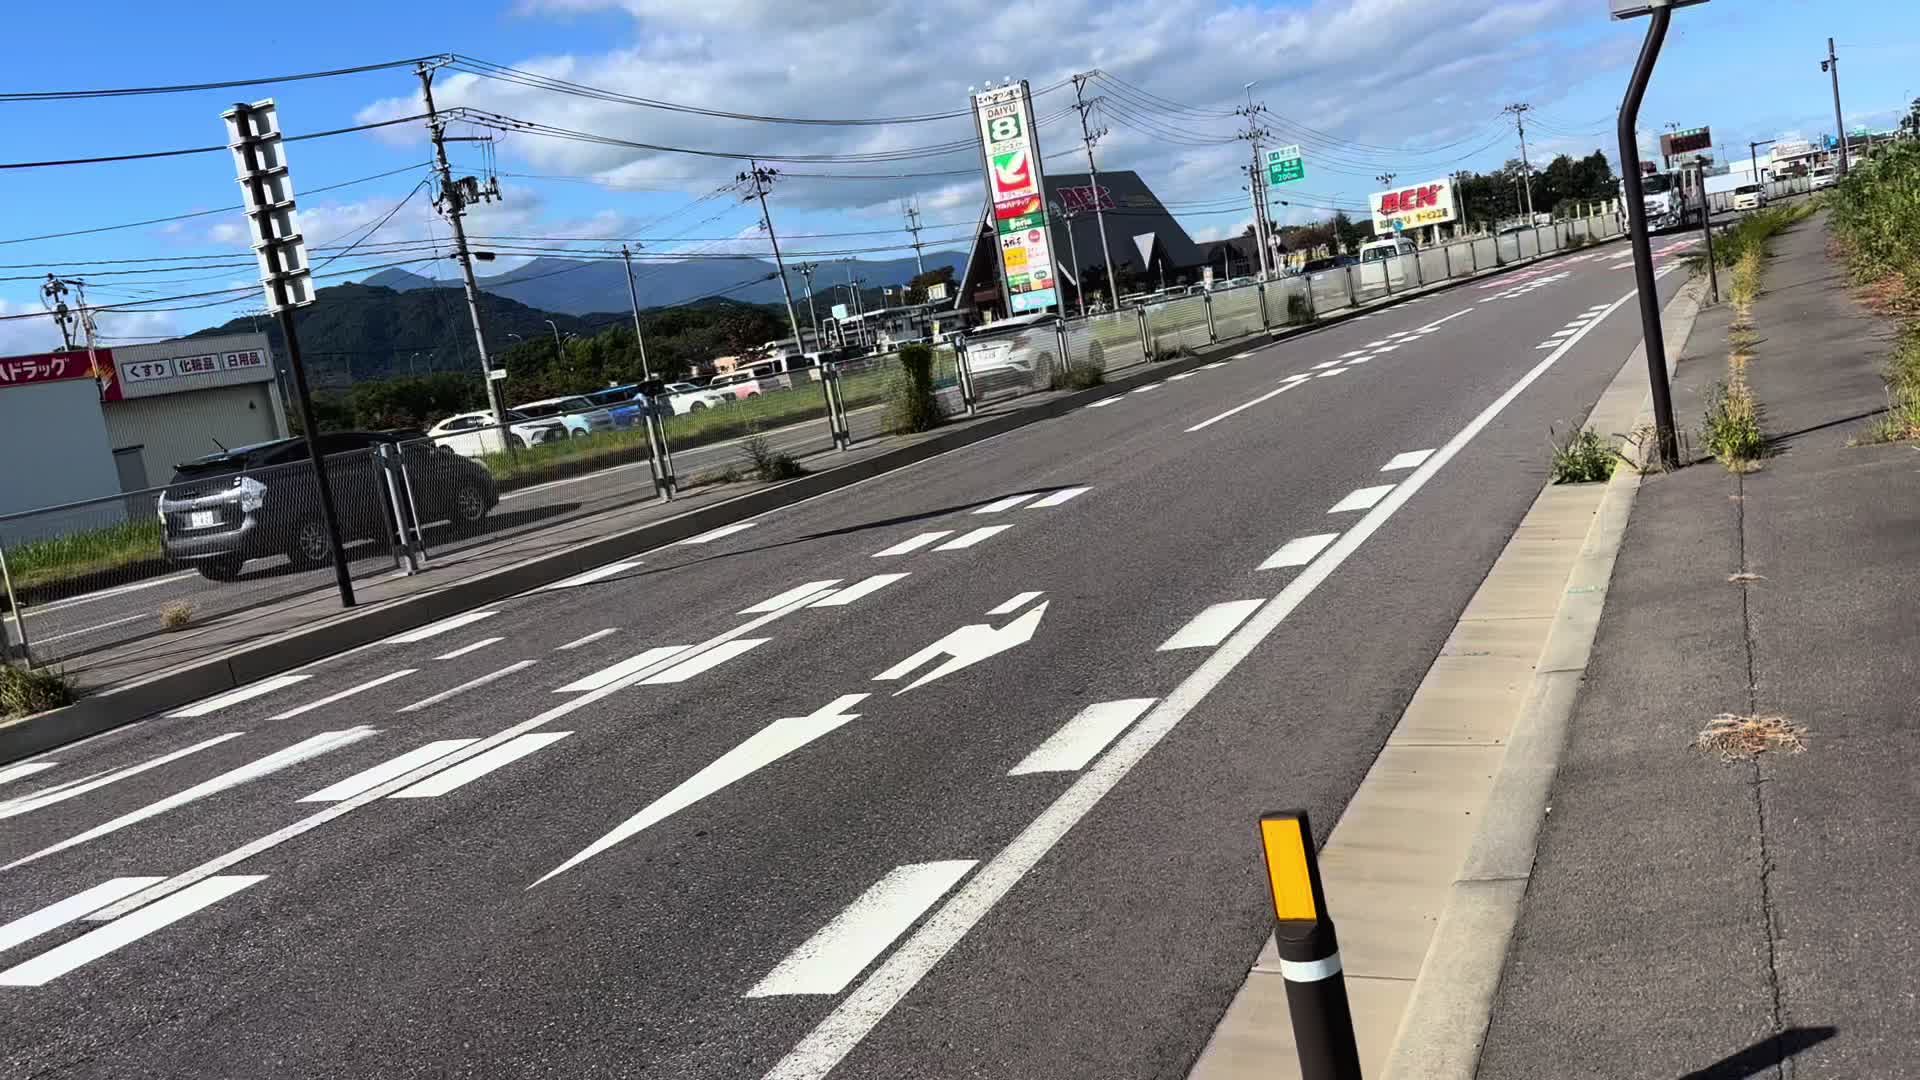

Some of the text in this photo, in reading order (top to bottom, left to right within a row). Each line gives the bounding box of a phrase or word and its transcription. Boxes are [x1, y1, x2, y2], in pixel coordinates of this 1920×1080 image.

[987, 103, 1016, 118] DAIYU
[991, 116, 1019, 141] 8
[179, 357, 216, 373] 化粧品
[227, 351, 260, 367] 日用品
[130, 363, 165, 378] くすり
